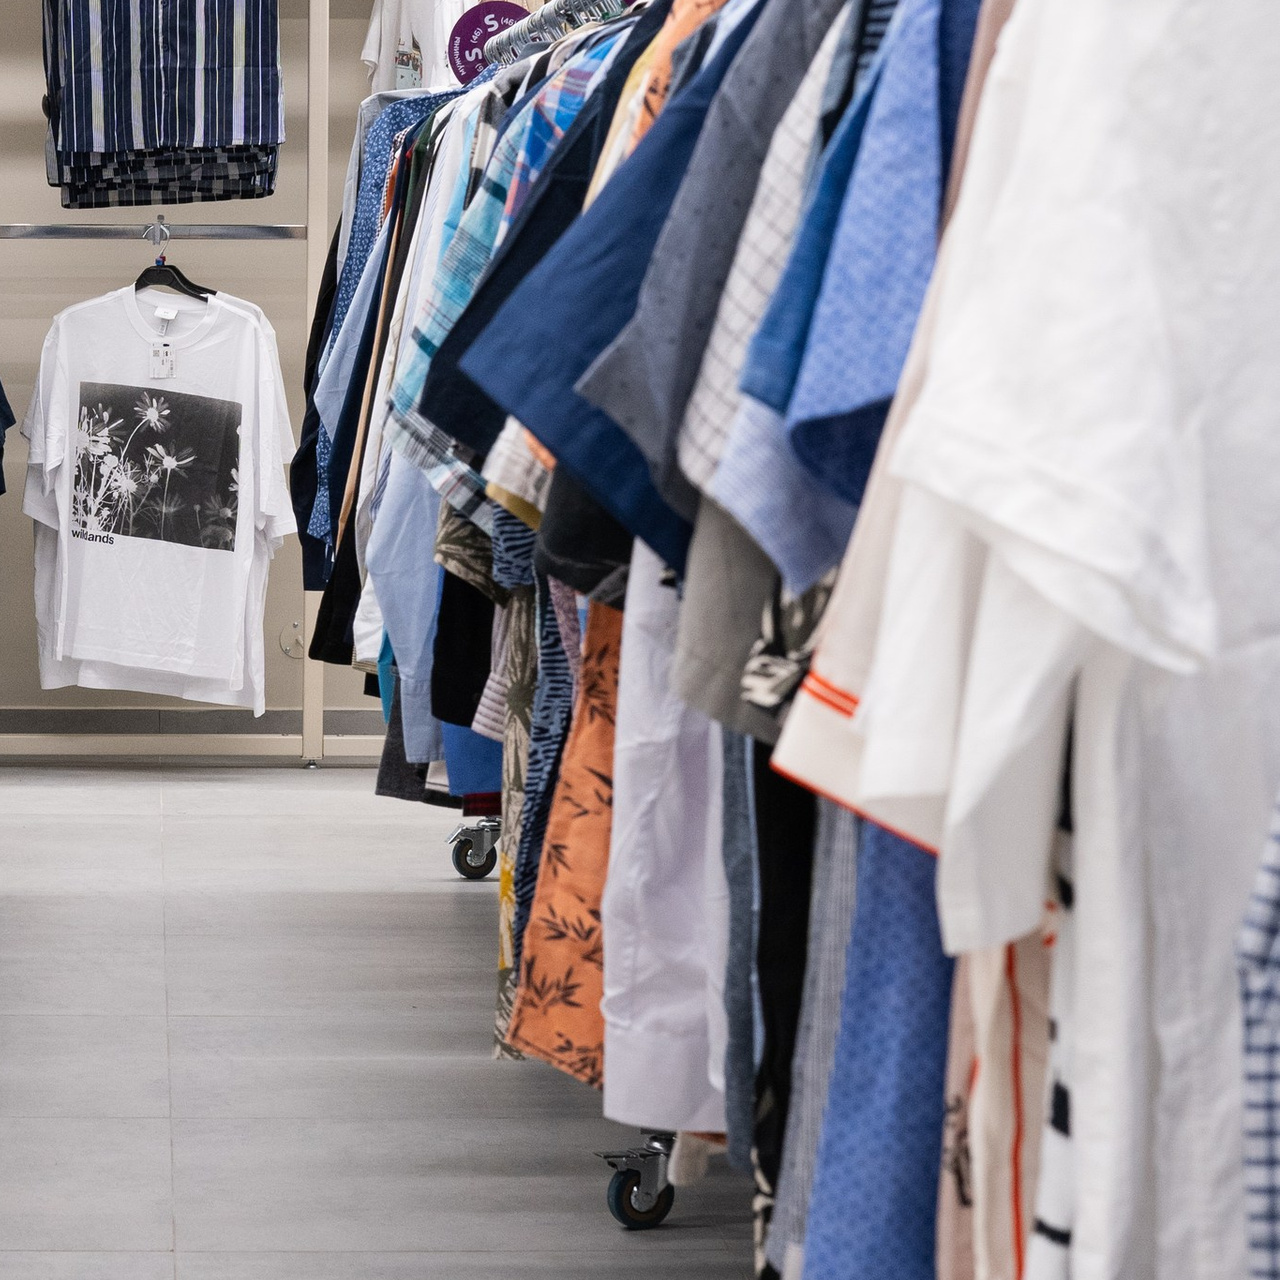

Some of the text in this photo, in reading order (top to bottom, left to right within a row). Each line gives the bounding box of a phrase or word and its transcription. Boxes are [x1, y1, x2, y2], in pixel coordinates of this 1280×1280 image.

[483, 13, 499, 33] S
[470, 27, 483, 44] (46)
[464, 47, 483, 62] S
